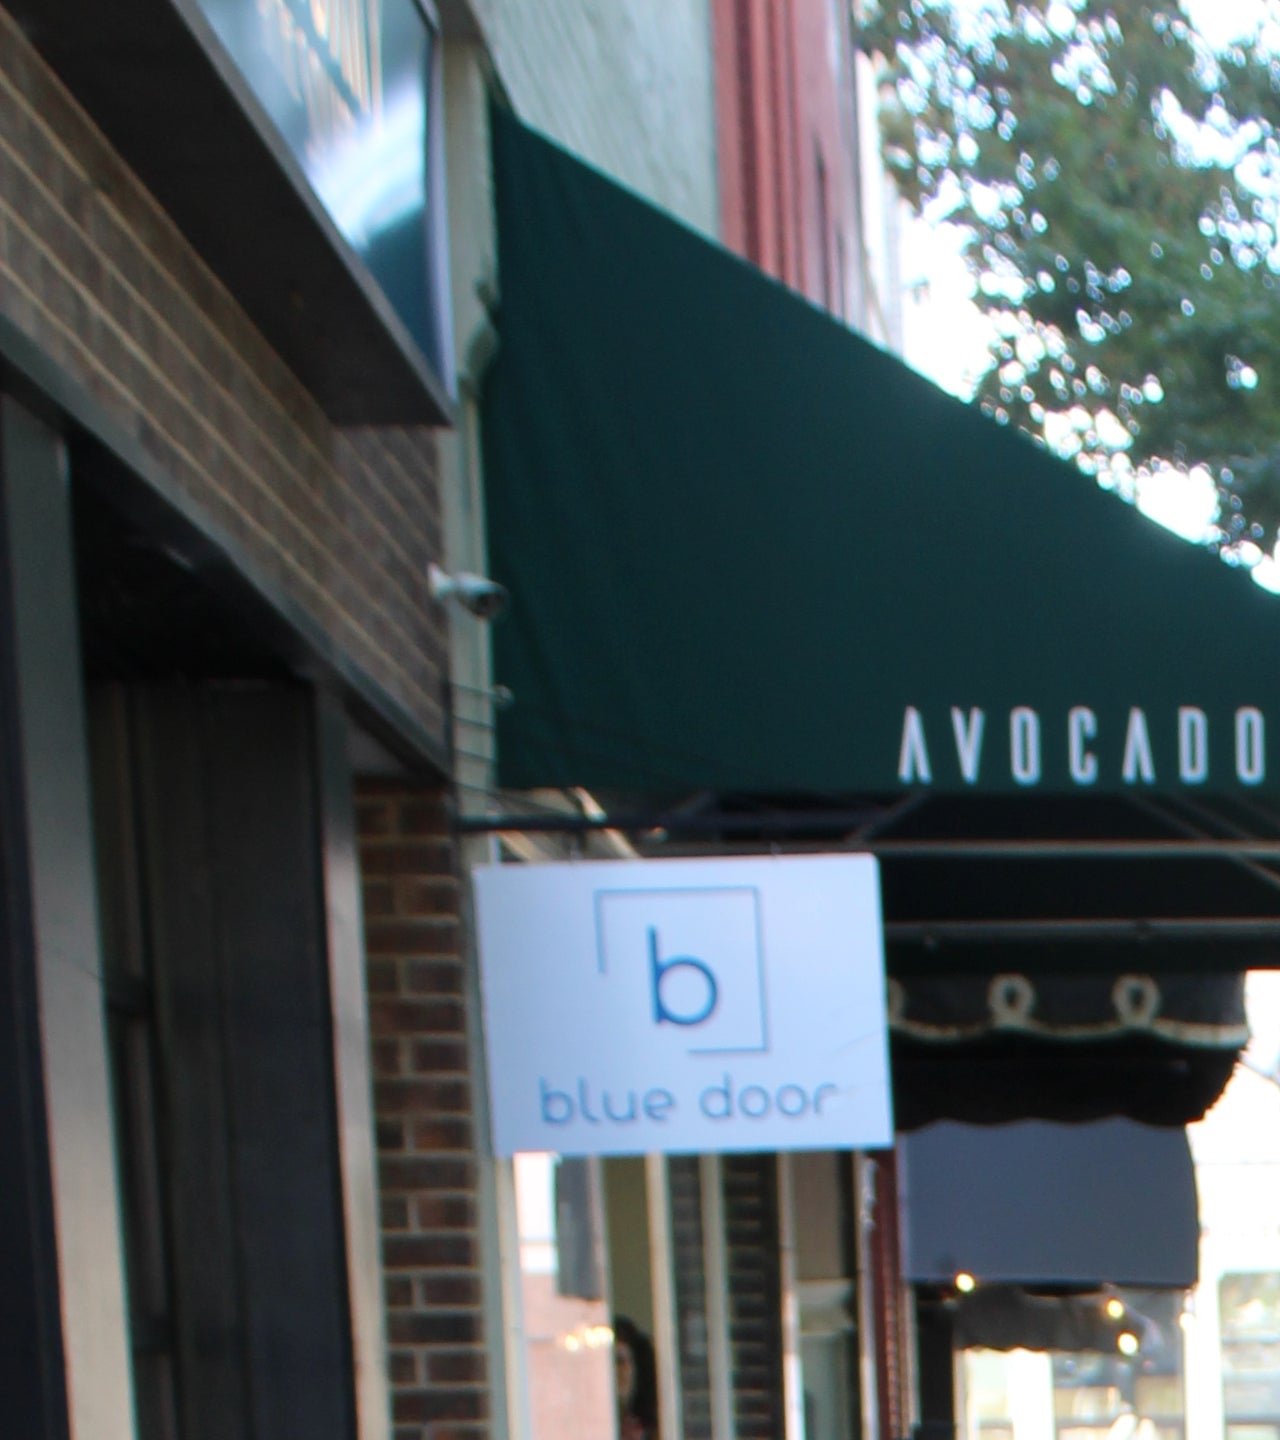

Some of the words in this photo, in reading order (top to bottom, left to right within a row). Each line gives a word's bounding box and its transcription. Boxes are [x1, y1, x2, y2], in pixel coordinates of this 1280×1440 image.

[646, 922, 719, 1027] b
[538, 1075, 676, 1125] blue
[699, 1071, 840, 1121] door
